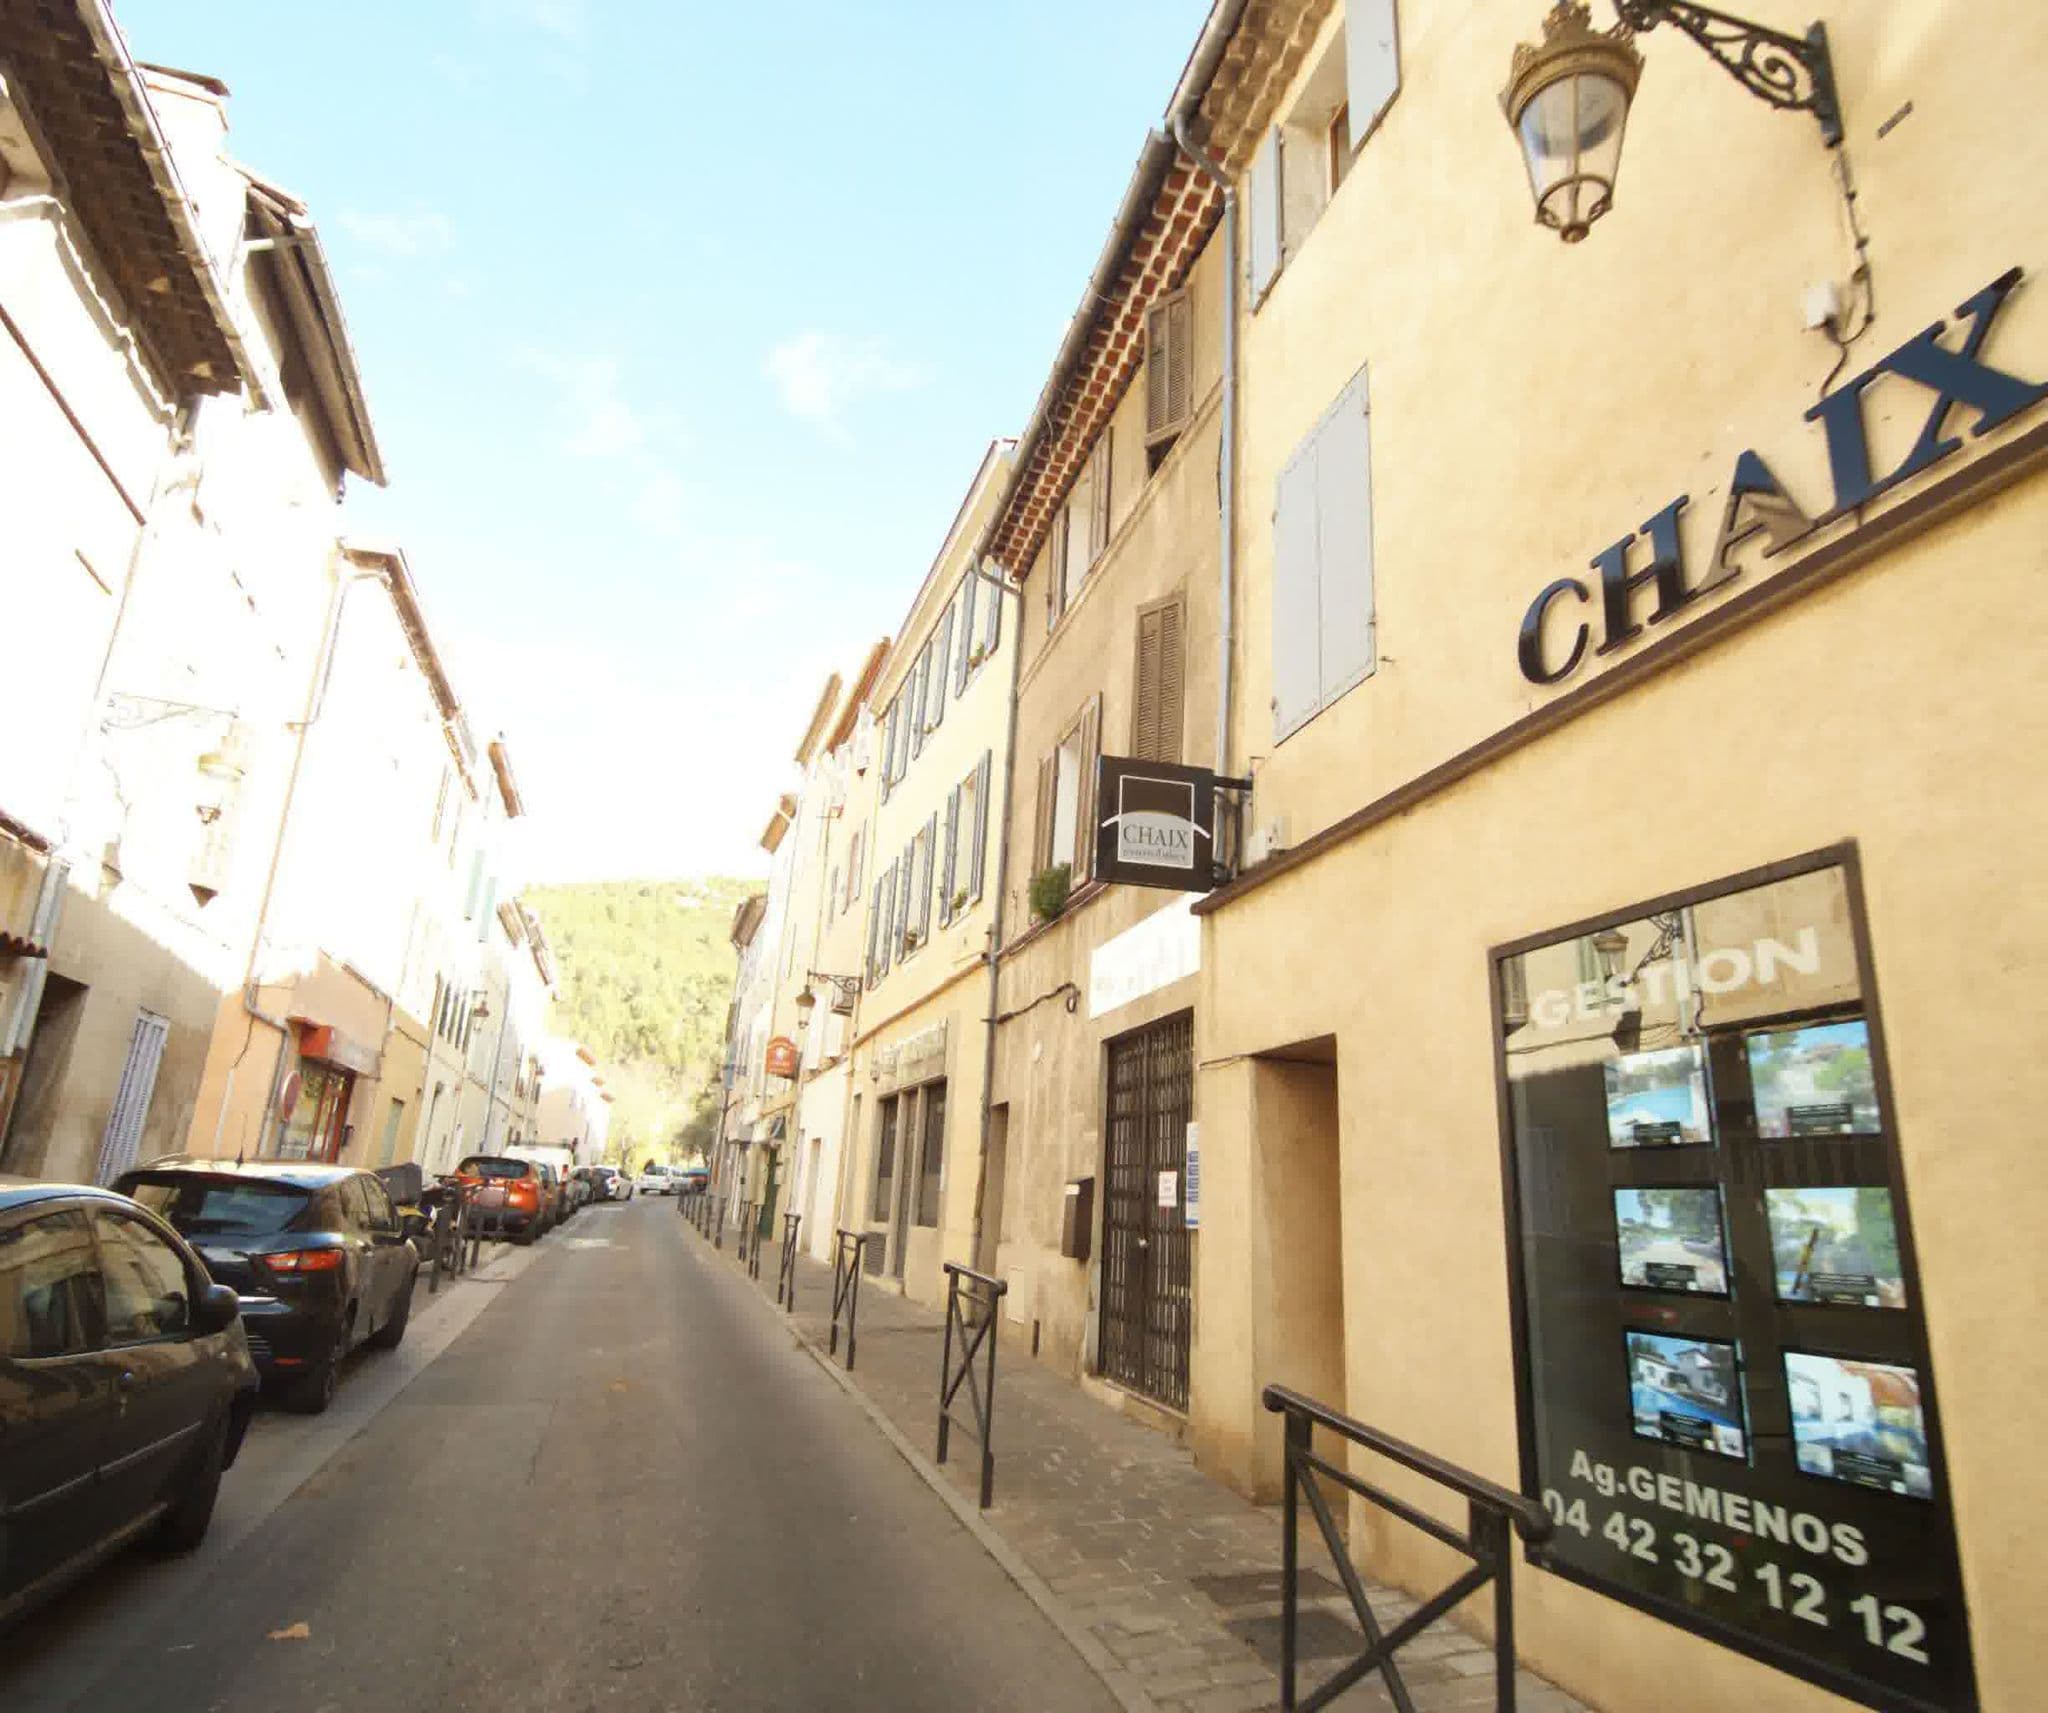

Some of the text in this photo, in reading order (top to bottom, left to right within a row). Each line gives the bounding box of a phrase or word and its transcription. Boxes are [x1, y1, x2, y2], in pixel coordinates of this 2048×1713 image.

[1518, 266, 2048, 685] CHAIX
[1123, 823, 1188, 849] CHAIX
[1531, 926, 1821, 1028] GESTION
[1569, 1449, 1868, 1566] Ag.GEMENOS
[1543, 1489, 1929, 1665] 04 42 32 12 12
